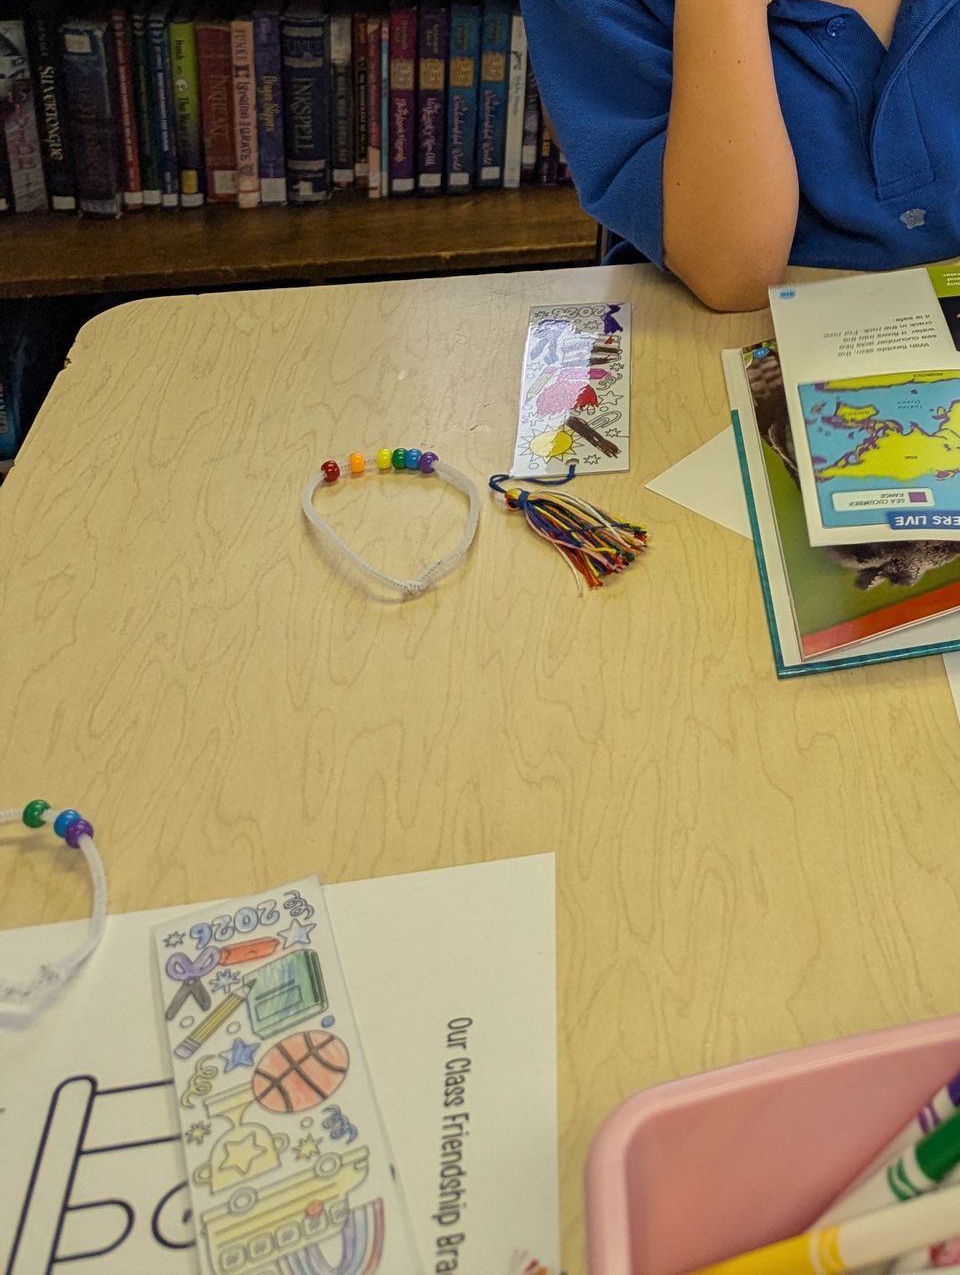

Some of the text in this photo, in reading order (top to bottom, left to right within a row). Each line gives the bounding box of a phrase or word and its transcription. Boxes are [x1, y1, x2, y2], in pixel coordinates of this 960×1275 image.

[894, 514, 927, 528] LIVE
[190, 899, 280, 949] 2026
[447, 1017, 473, 1050] Our
[444, 1058, 473, 1107] Class
[432, 1112, 469, 1227] Friendship
